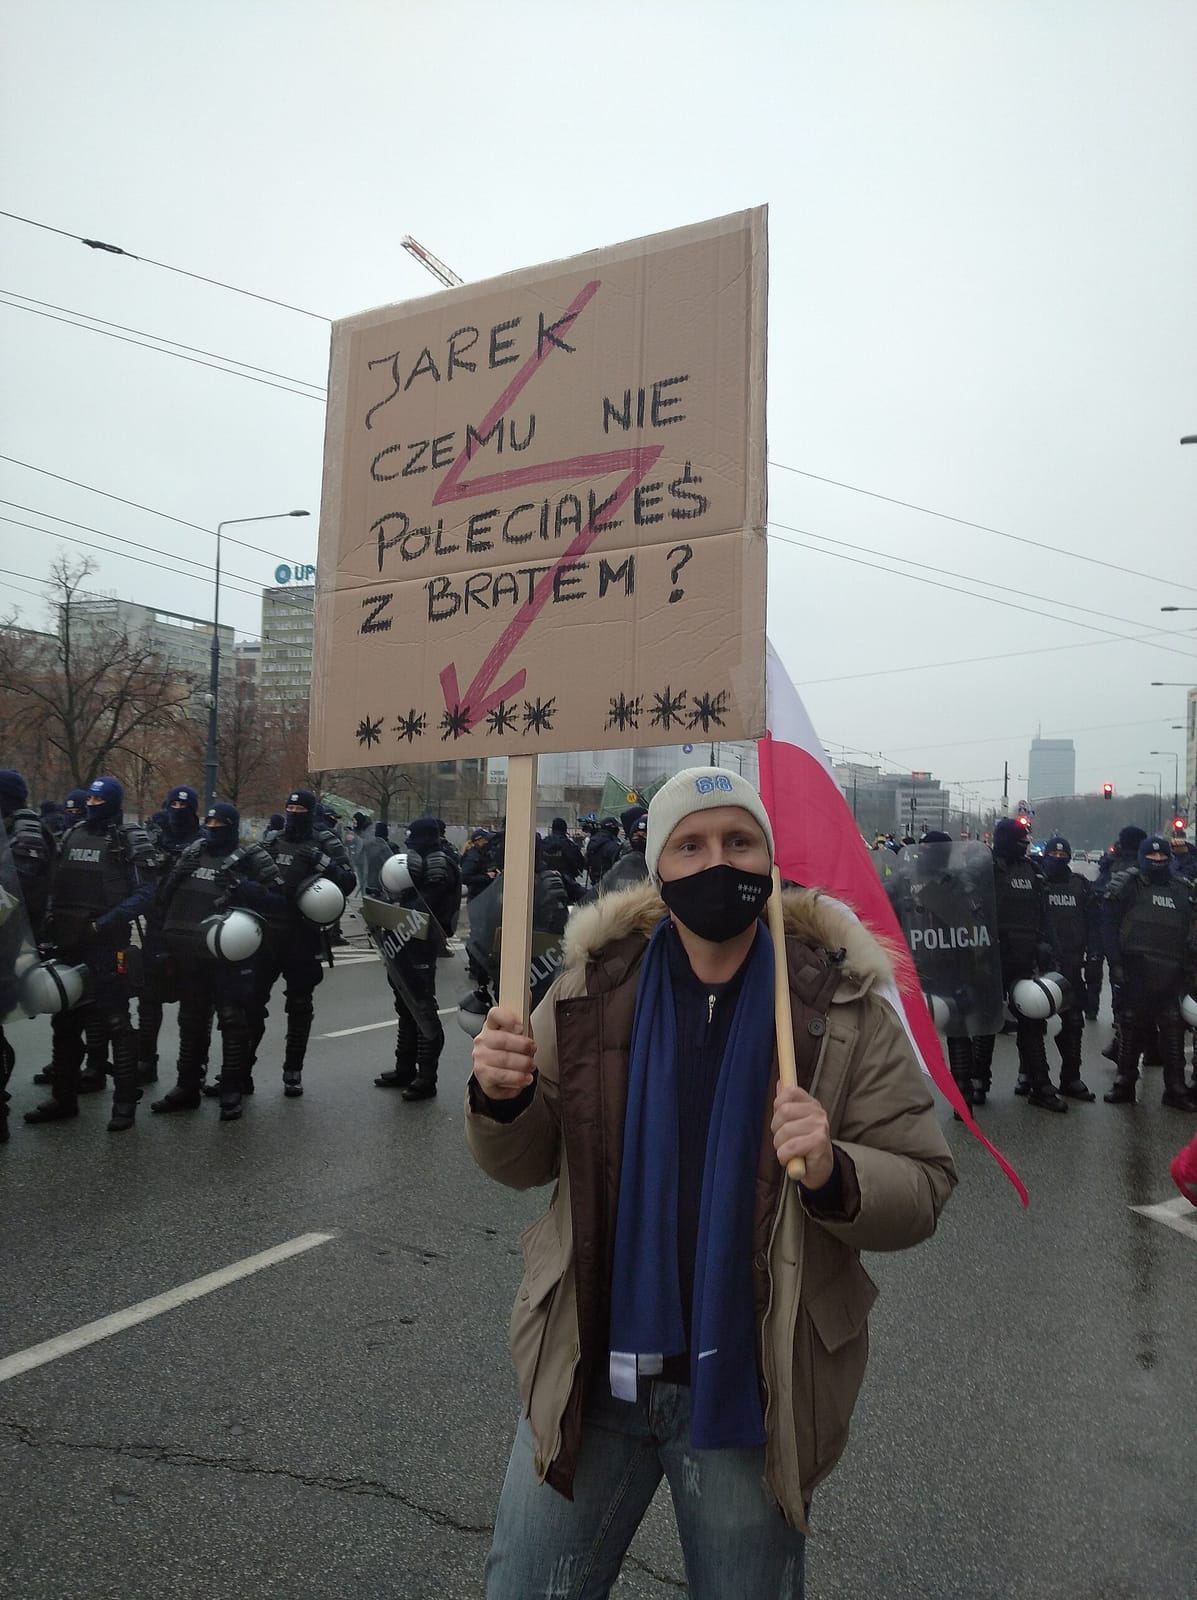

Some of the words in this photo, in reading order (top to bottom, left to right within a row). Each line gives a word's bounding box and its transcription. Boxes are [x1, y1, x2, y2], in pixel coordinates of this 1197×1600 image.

[367, 312, 580, 429] JAREK
[370, 414, 536, 482] CZEMU
[603, 375, 690, 433] NIE
[358, 594, 393, 634] Z
[1048, 894, 1077, 907] POLICJA
[910, 925, 991, 951] POLICJA
